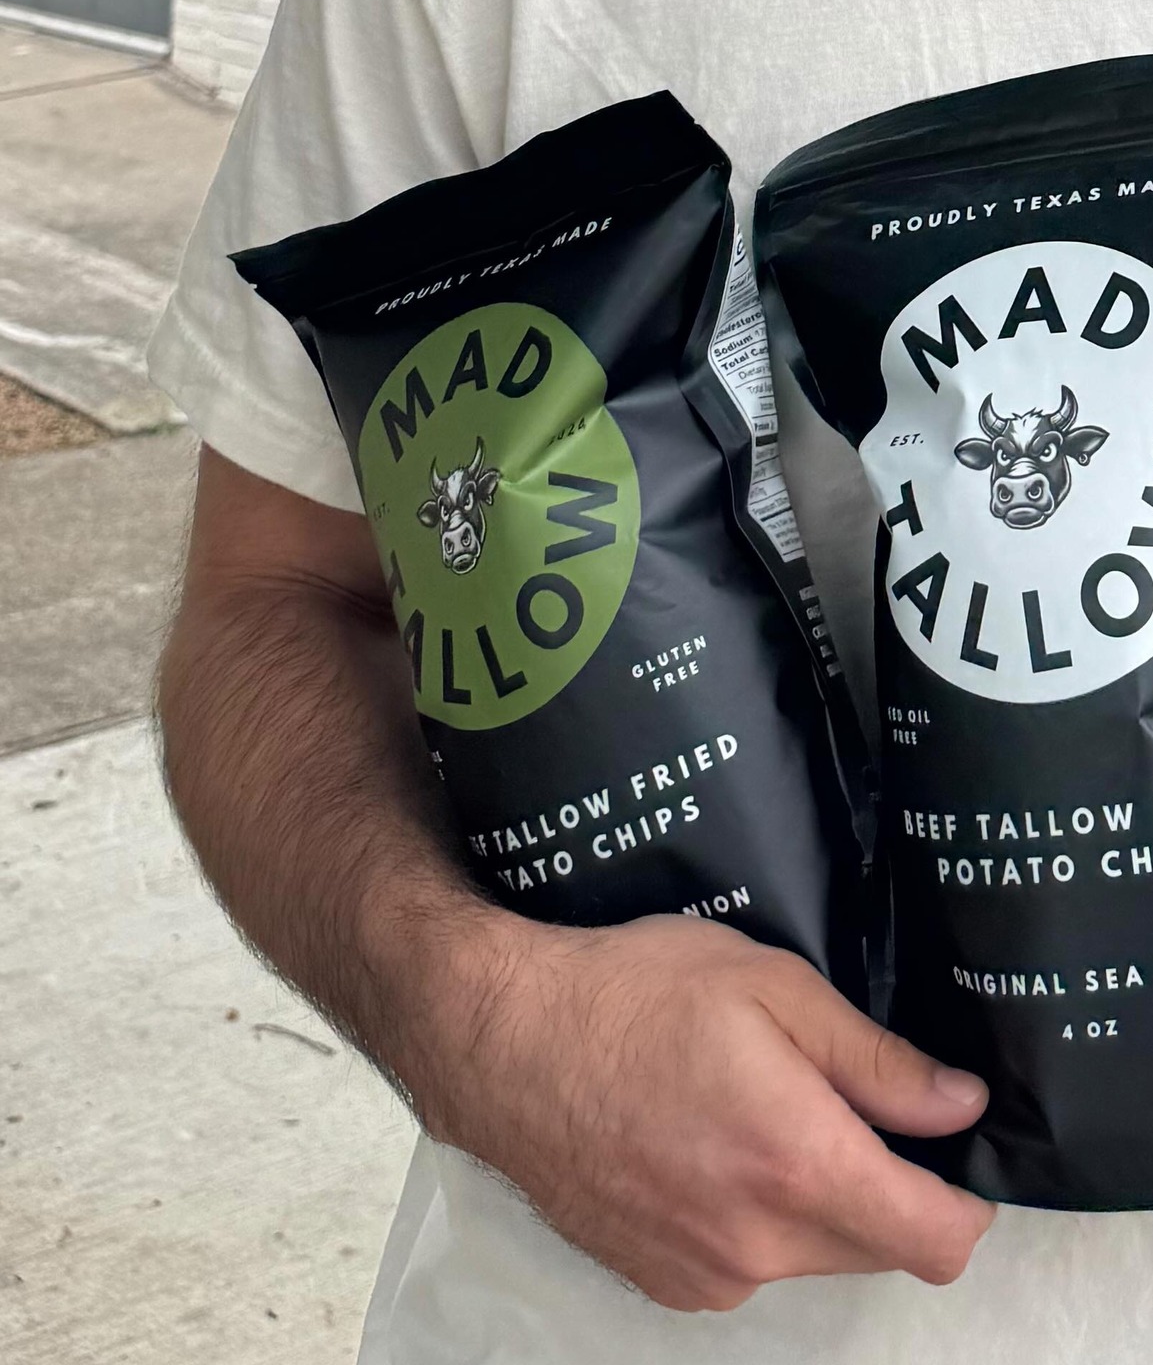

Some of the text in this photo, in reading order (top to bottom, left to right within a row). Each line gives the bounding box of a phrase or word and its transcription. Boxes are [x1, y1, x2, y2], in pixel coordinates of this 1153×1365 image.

[871, 201, 997, 241] PROUDLY
[1013, 187, 1102, 214] TEXAS
[374, 216, 613, 315] PROUDLY TEXAS MADE
[713, 334, 754, 358] Sodium
[900, 266, 1150, 394] MAD
[720, 352, 750, 371] Total
[380, 325, 553, 464] MAD
[890, 433, 924, 447] EST.
[632, 635, 707, 678] GLUTEN
[652, 660, 699, 692] FREE
[907, 709, 931, 725] OIL
[492, 788, 611, 855] TALLOW
[630, 734, 739, 800] FRIED
[903, 809, 957, 841] BEEF
[976, 802, 1134, 841] TALLOW
[497, 795, 701, 892] TATO CHIPS
[937, 854, 1076, 887] POTATO
[682, 885, 751, 917] NION
[953, 966, 1067, 997] ORIGINAL
[1085, 965, 1144, 992] SEA
[1062, 1019, 1119, 1040] 4 OZ
